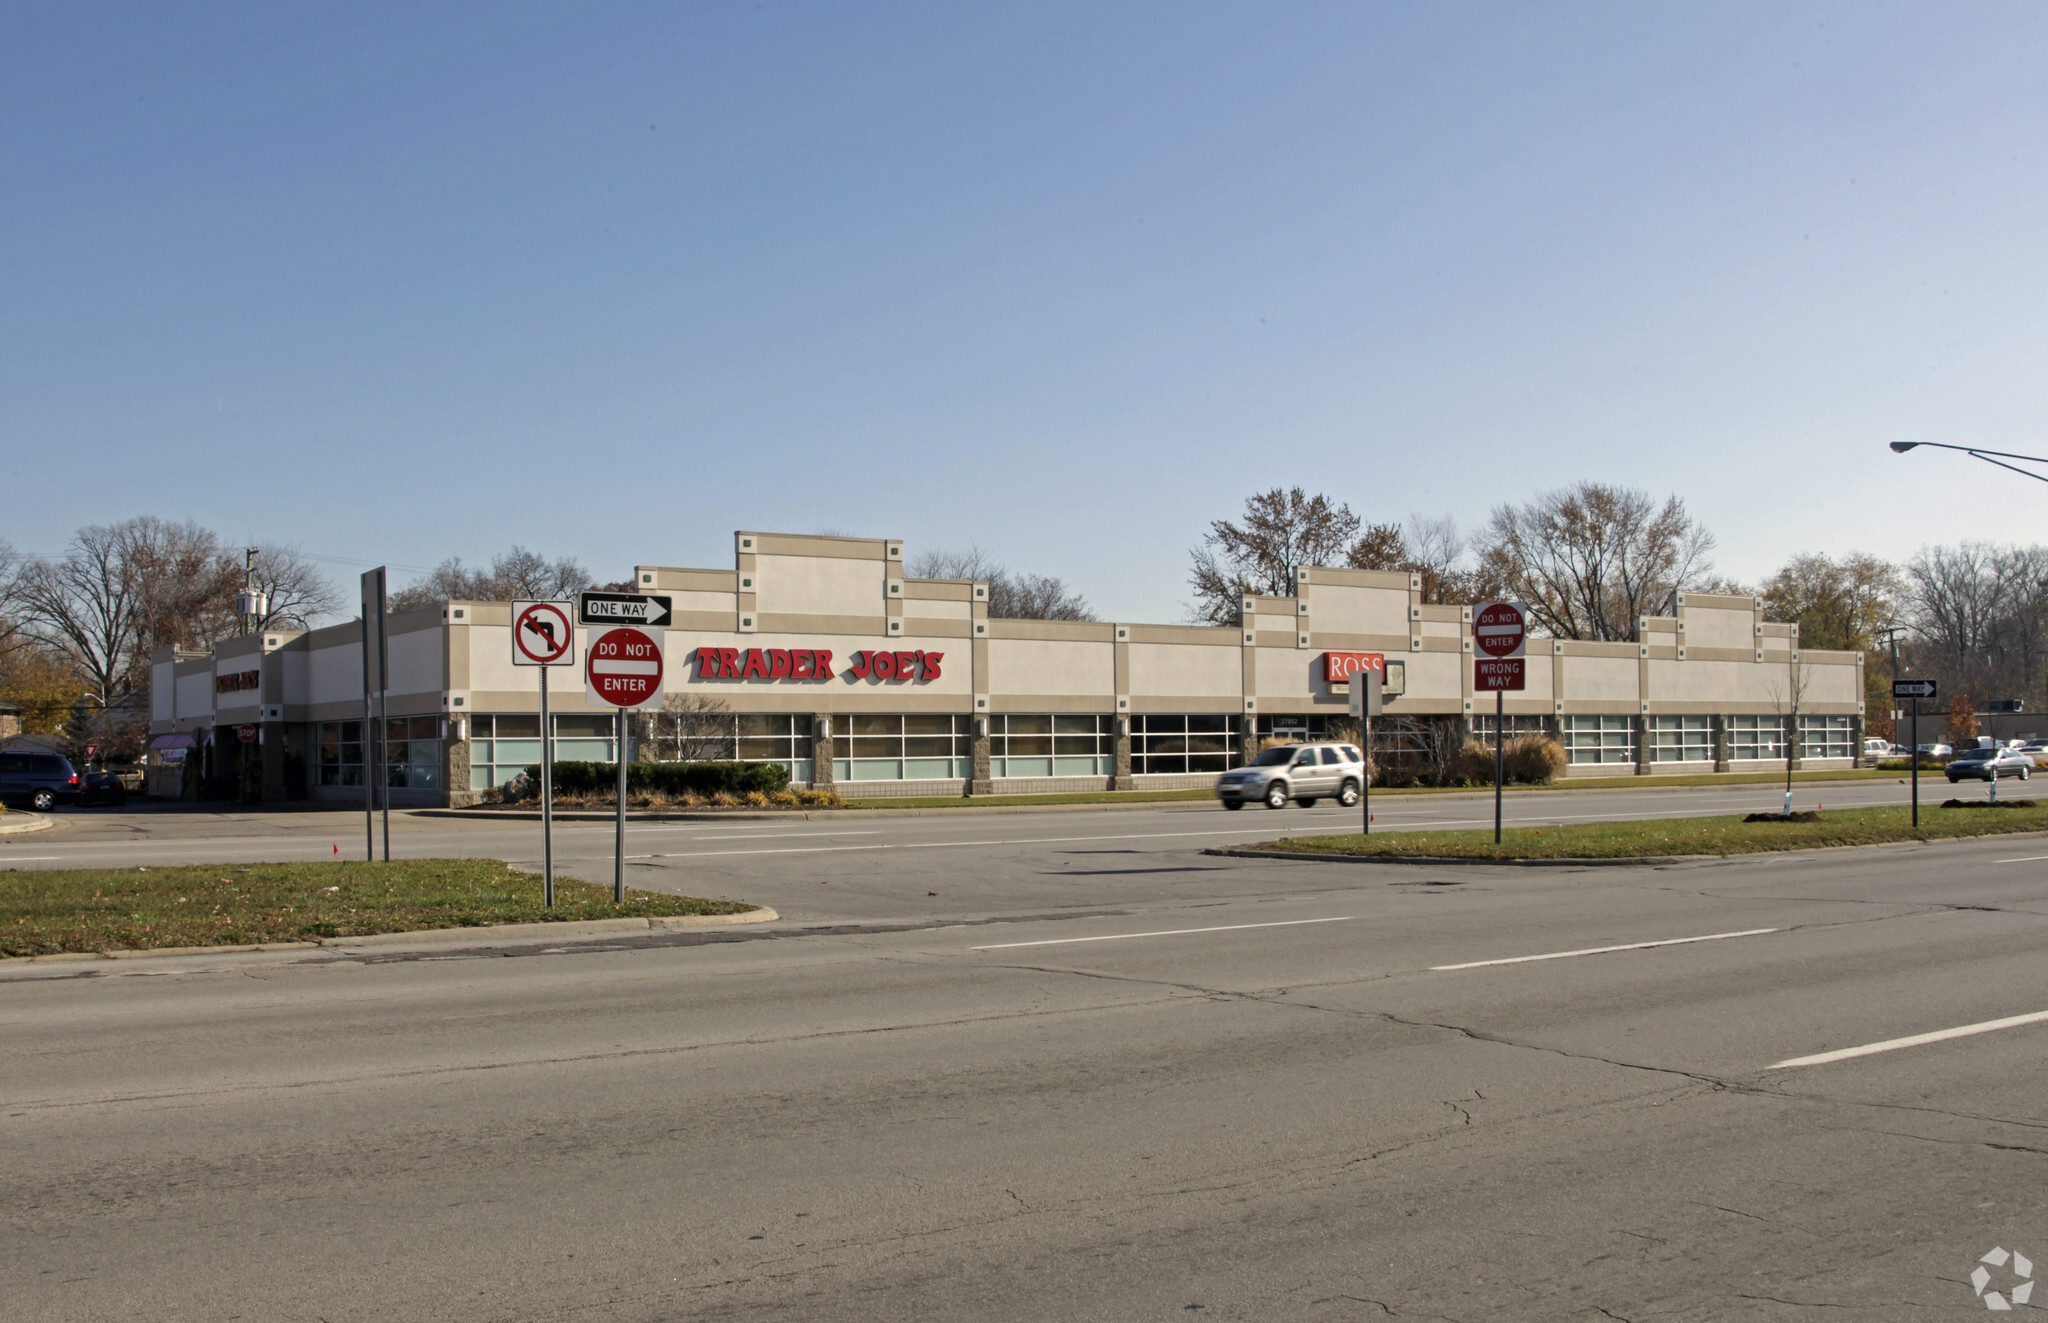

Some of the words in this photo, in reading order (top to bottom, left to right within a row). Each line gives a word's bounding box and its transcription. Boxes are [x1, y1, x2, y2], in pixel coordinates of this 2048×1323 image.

[590, 602, 618, 614] ONE
[622, 604, 648, 615] WAY
[1482, 615, 1494, 623] DO
[1499, 613, 1517, 622] NOT
[1486, 638, 1513, 646] ENTER
[599, 643, 617, 655] DO
[626, 644, 652, 656] NOT
[694, 647, 836, 679] TRADER
[849, 649, 945, 680] JOE'S
[1331, 656, 1381, 677] ROSS
[1480, 663, 1519, 674] WRONG
[604, 678, 646, 691] ENTER
[1488, 676, 1511, 686] WAY
